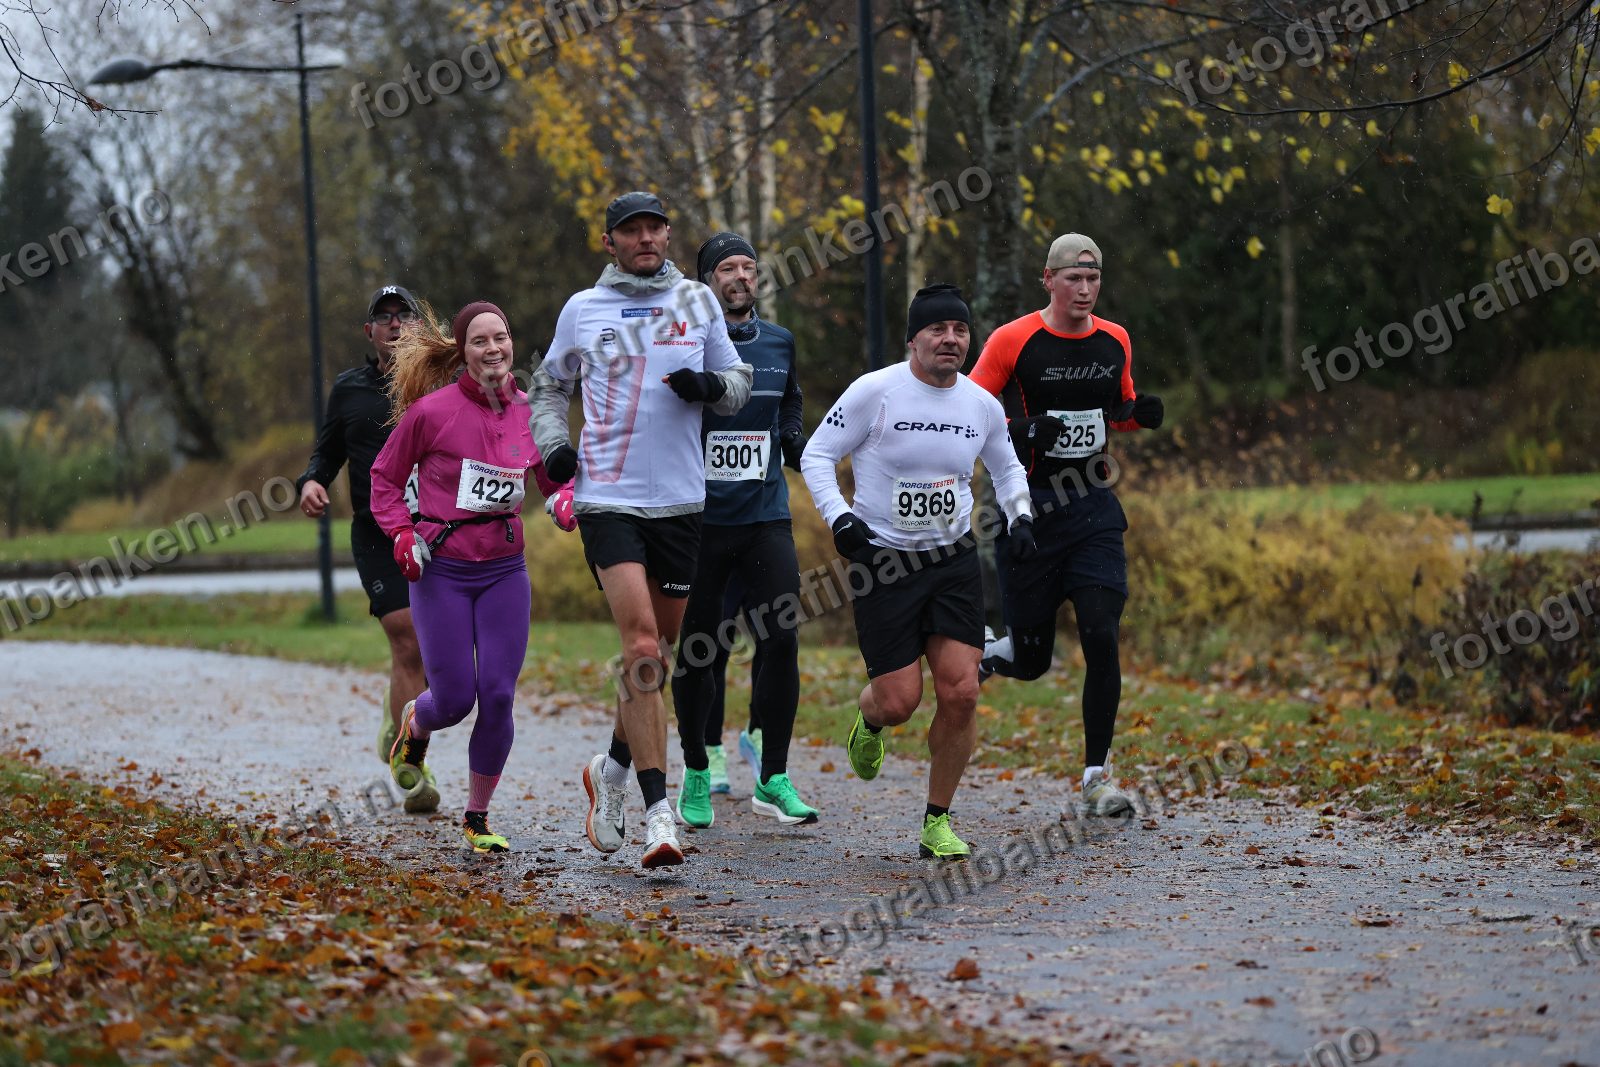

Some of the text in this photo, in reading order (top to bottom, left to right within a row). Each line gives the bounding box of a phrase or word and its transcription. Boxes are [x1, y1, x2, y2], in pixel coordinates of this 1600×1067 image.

[893, 421, 964, 434] CRAFT
[711, 444, 763, 469] 3001
[471, 476, 515, 504] 422
[898, 478, 955, 489] NORGESTESTEN
[898, 489, 956, 518] 9369
